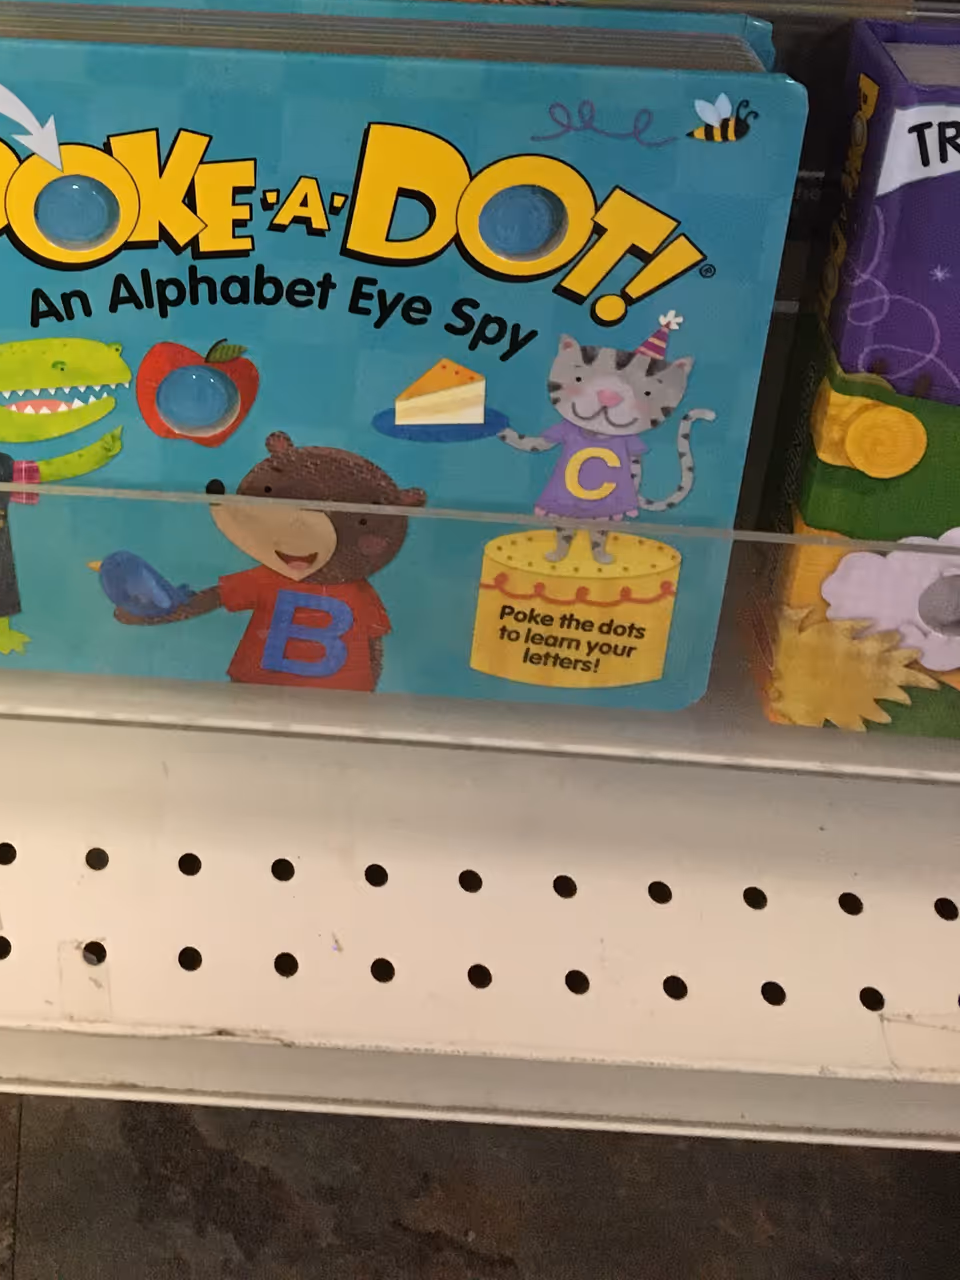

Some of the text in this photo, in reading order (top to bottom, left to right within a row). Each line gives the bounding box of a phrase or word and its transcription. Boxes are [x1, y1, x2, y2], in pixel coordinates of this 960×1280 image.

[907, 120, 960, 168] TR
[30, 263, 539, 362] An Alphabet Eye Spy
[564, 446, 621, 501] C
[260, 588, 355, 679] B
[498, 625, 637, 659] to learn your
[499, 605, 646, 640] Poke the dots
[522, 647, 601, 674] letters!
